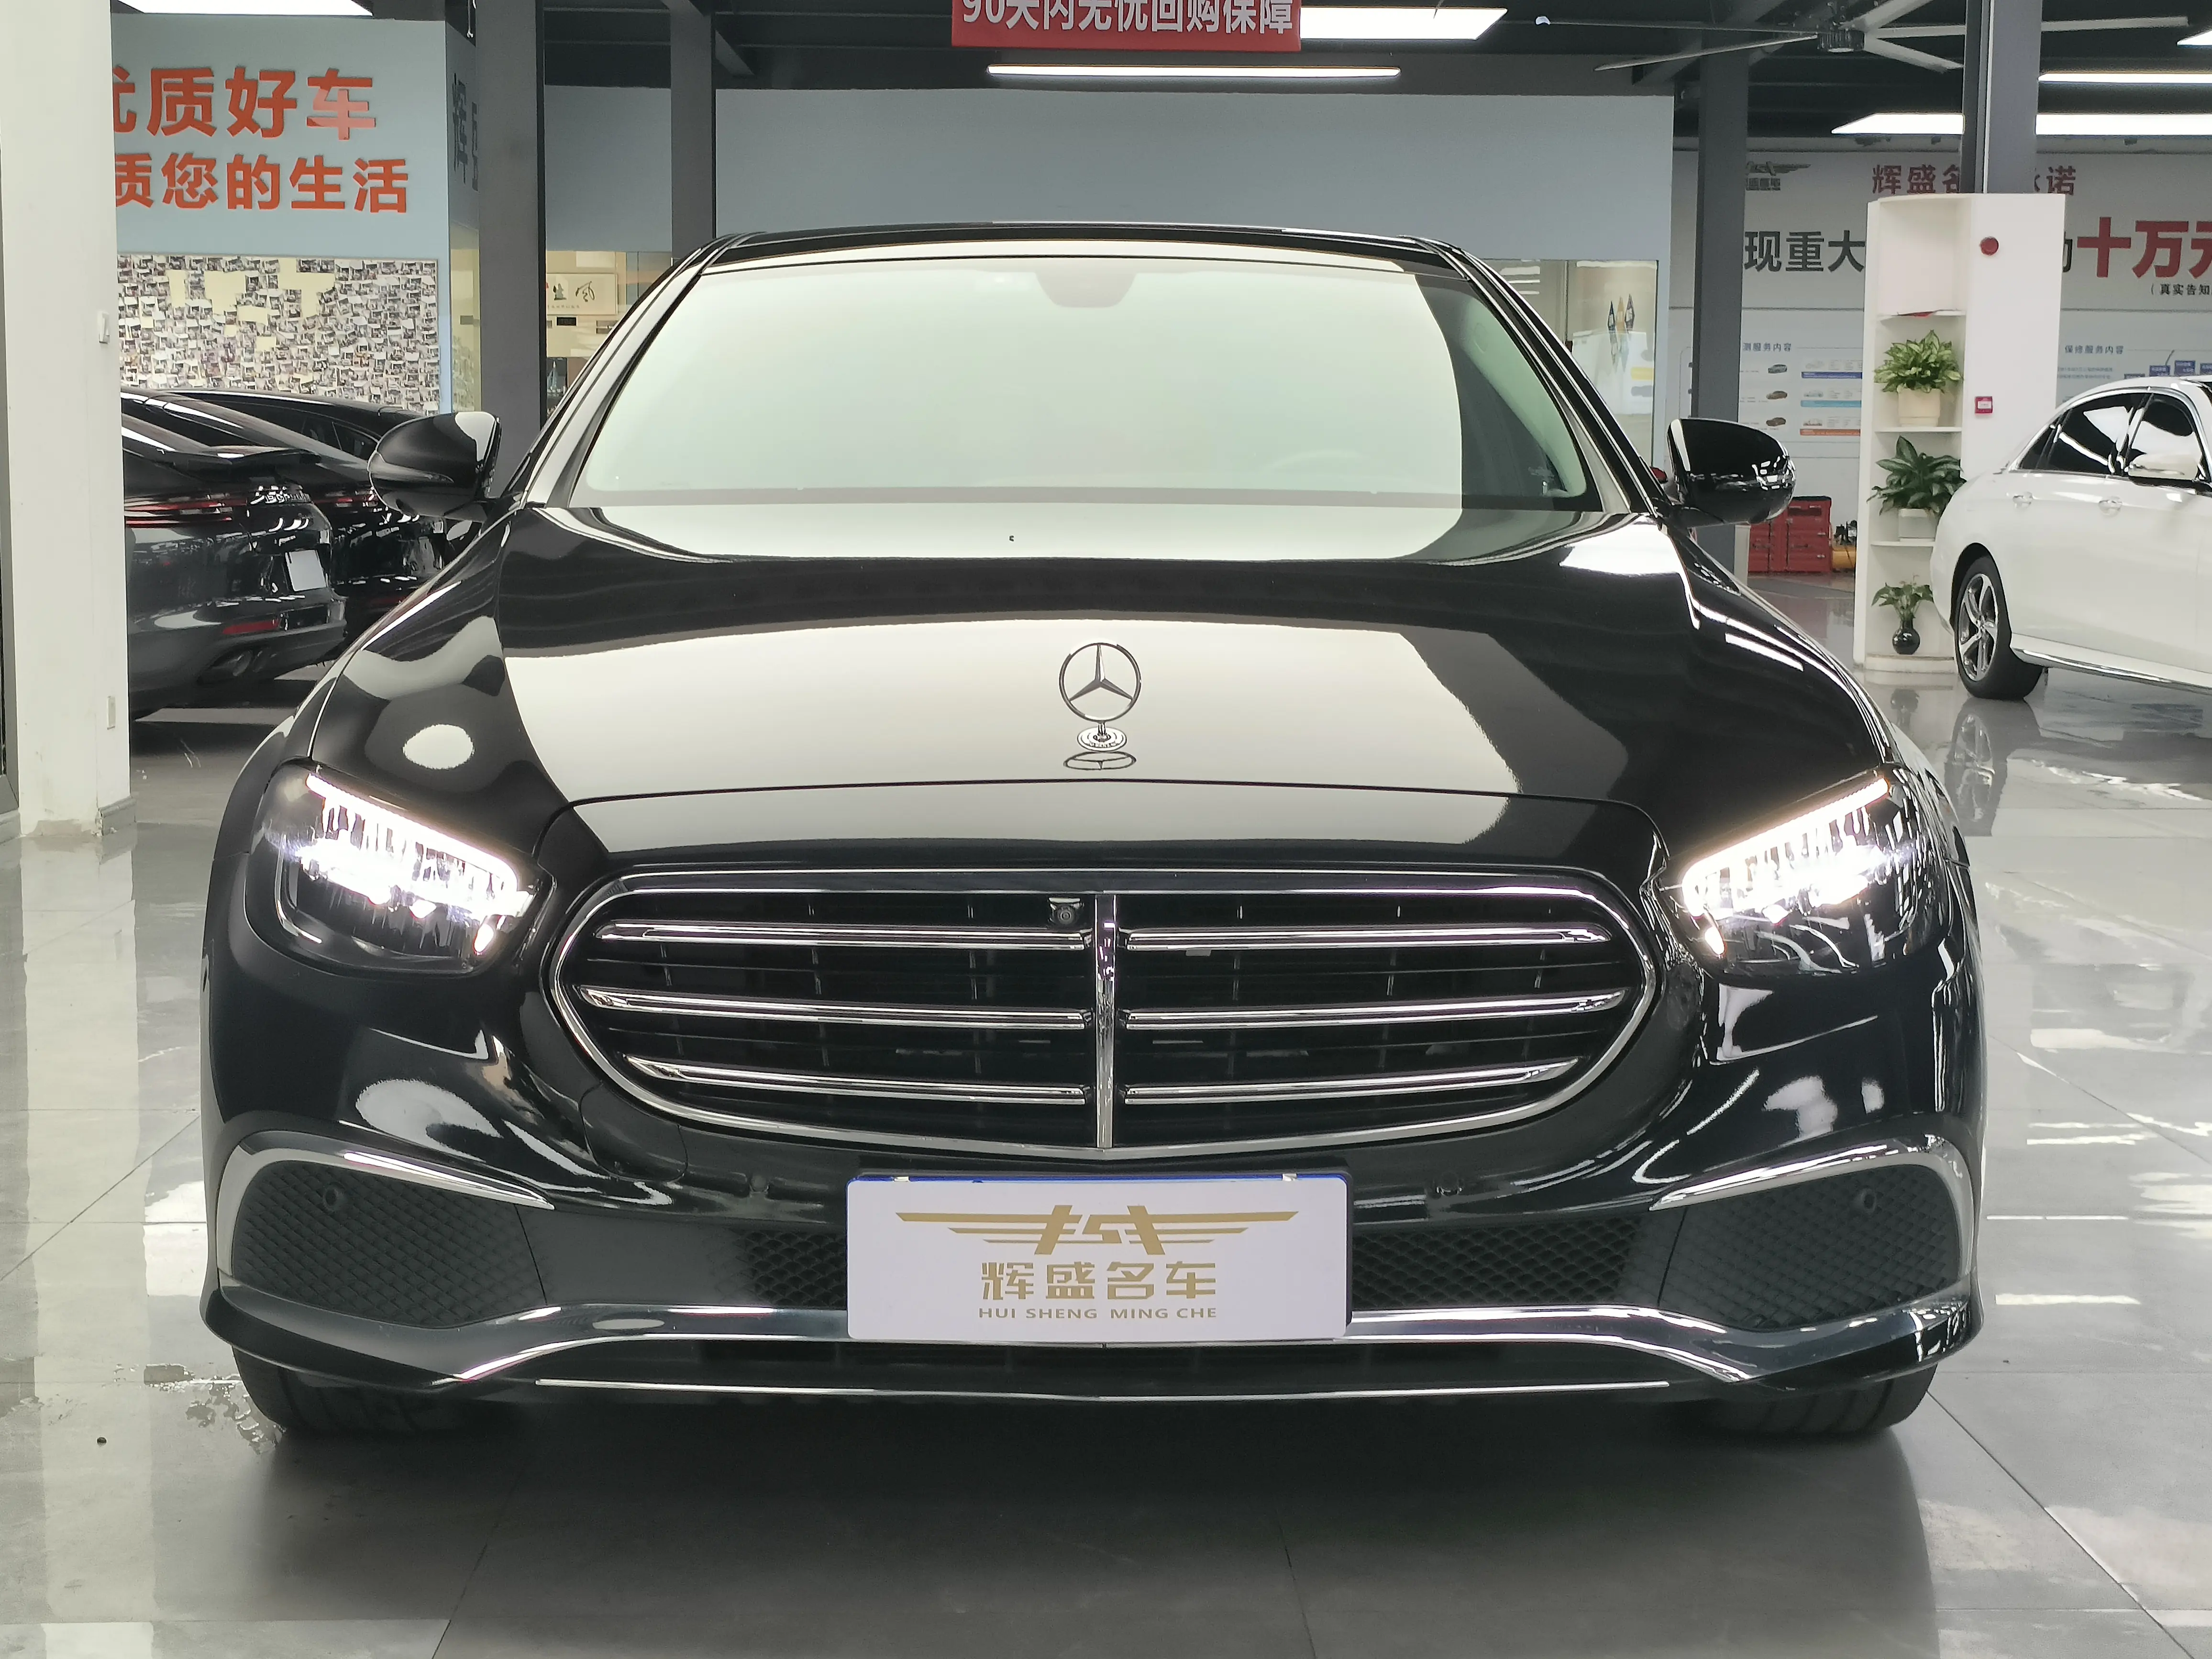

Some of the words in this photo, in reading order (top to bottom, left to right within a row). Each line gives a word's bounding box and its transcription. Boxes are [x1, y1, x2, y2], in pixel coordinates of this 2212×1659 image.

[981, 1261, 1216, 1300] 辉盛名车
[979, 1308, 1016, 1319] HUI
[1027, 1308, 1098, 1319] SHENG
[1110, 1308, 1169, 1319] MING
[1176, 1307, 1217, 1319] CHE
